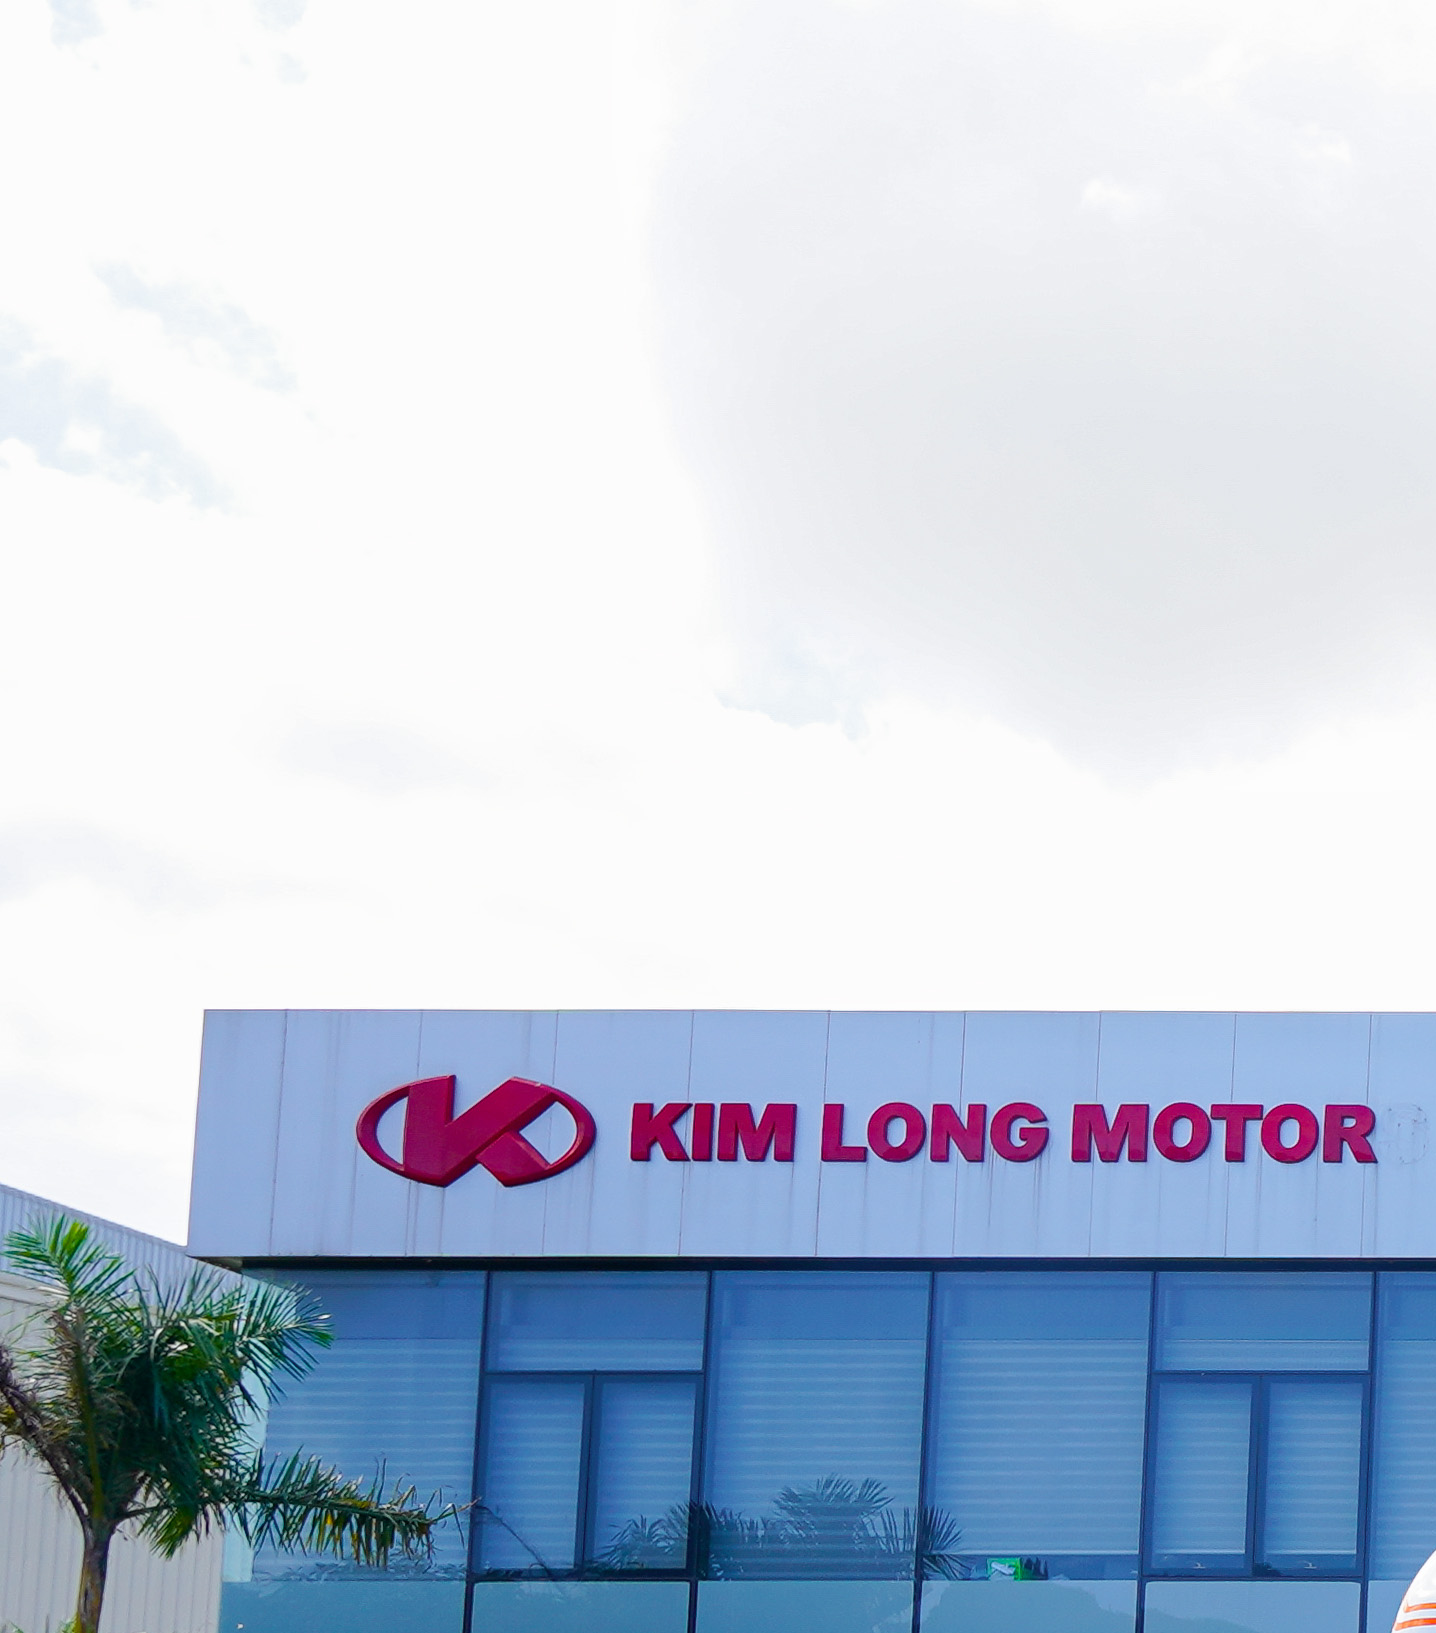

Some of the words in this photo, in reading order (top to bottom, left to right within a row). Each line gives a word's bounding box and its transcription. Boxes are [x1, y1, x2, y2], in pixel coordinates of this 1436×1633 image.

[630, 1102, 797, 1162] KIM
[821, 1102, 1050, 1163] LONG
[1071, 1102, 1377, 1164] MOTOR
